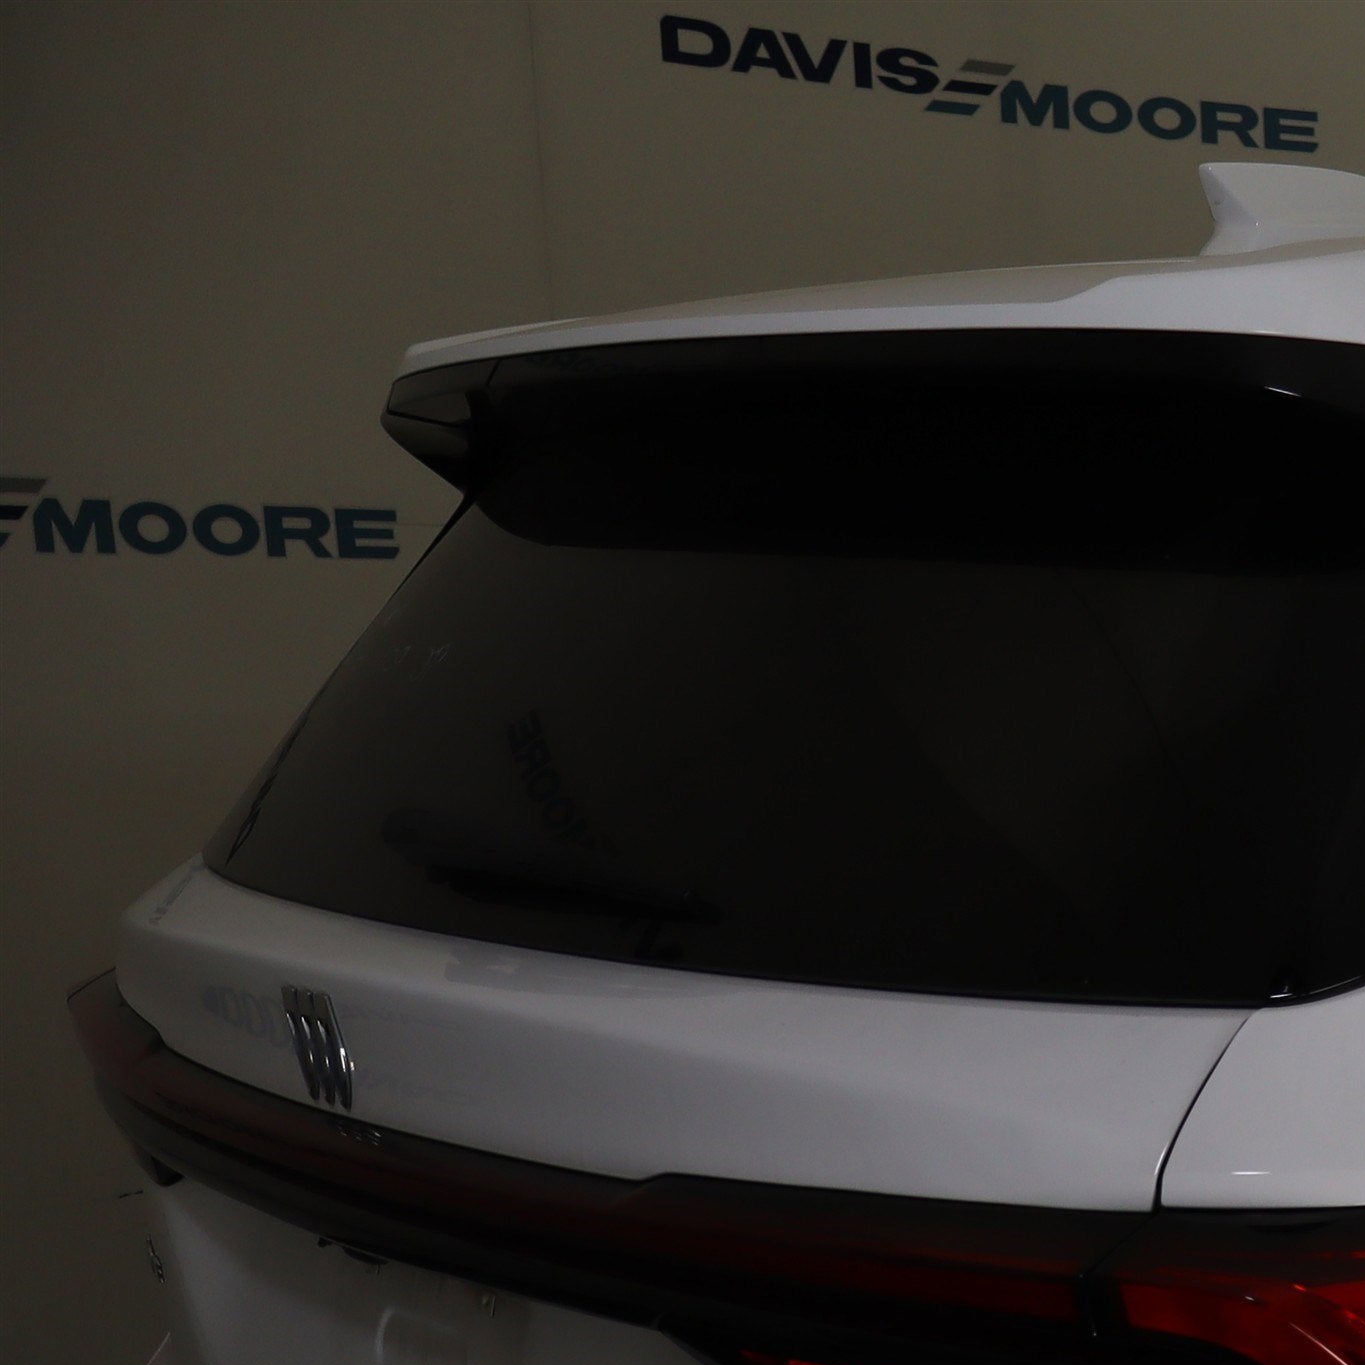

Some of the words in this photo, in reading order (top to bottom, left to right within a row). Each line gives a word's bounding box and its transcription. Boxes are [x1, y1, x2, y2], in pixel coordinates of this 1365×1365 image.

[659, 15, 939, 95] DAVIS
[1000, 80, 1319, 153] MOORE
[33, 498, 400, 559] MOORE
